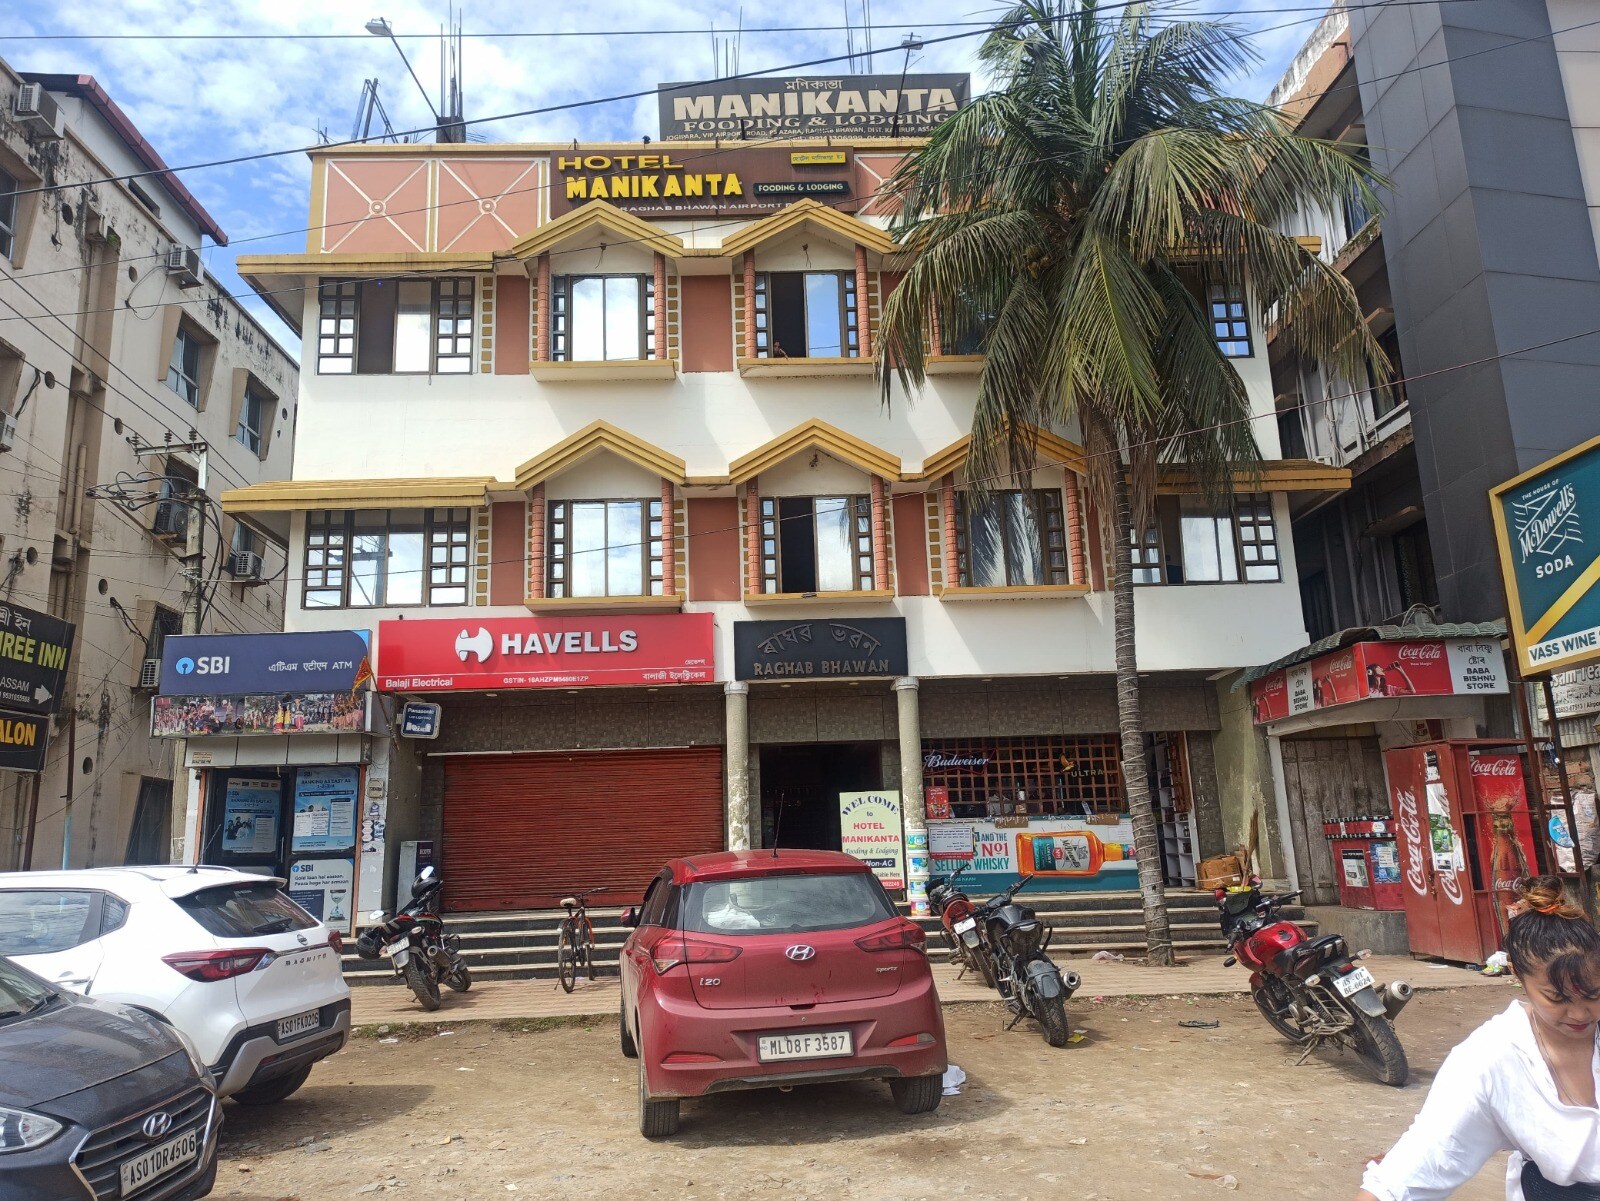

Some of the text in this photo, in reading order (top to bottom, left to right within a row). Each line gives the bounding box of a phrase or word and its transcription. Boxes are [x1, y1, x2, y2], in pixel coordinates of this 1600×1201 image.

[673, 88, 958, 121] MANIKANTA
[683, 112, 950, 132] FOODING & LODGING
[715, 130, 741, 138] AIRPOR
[558, 154, 684, 171] HOTEL
[566, 173, 742, 200] MANIKANTA
[758, 184, 796, 192] FOODING
[806, 183, 844, 191] LODGING
[729, 202, 782, 210] AIRPORT
[1521, 478, 1560, 501] THE HOUSE OF
[1520, 483, 1575, 564] McDowell's
[1536, 554, 1574, 579] SODA
[501, 629, 639, 656] HAVELLS
[1529, 631, 1597, 662] VASS WINE
[0, 631, 67, 671] REE INN
[1399, 645, 1441, 660] Coca-Cola
[196, 656, 230, 674] SBI
[332, 661, 353, 669] ATM
[754, 659, 889, 676] RAGHAB BHAWAN
[385, 677, 453, 689] Balaji Electrical
[925, 754, 989, 767] Budweiser
[1471, 759, 1518, 777] Coca-Cola
[1071, 769, 1104, 778] ULTRA
[853, 822, 885, 830] HOTEL
[842, 835, 900, 843] MANIKANTA
[981, 832, 995, 842] AND
[995, 832, 1008, 841] THE
[1396, 787, 1428, 896] Coca-Cola
[846, 847, 868, 855] Fooding
[875, 847, 899, 855] Lodging
[300, 864, 314, 872] SBI
[973, 857, 1010, 870] WHISKY
[285, 953, 327, 966] MAGNITE
[700, 977, 721, 986] i20
[770, 1035, 845, 1056] ML08 F 3587
[130, 1134, 195, 1186] AS01DR4506
